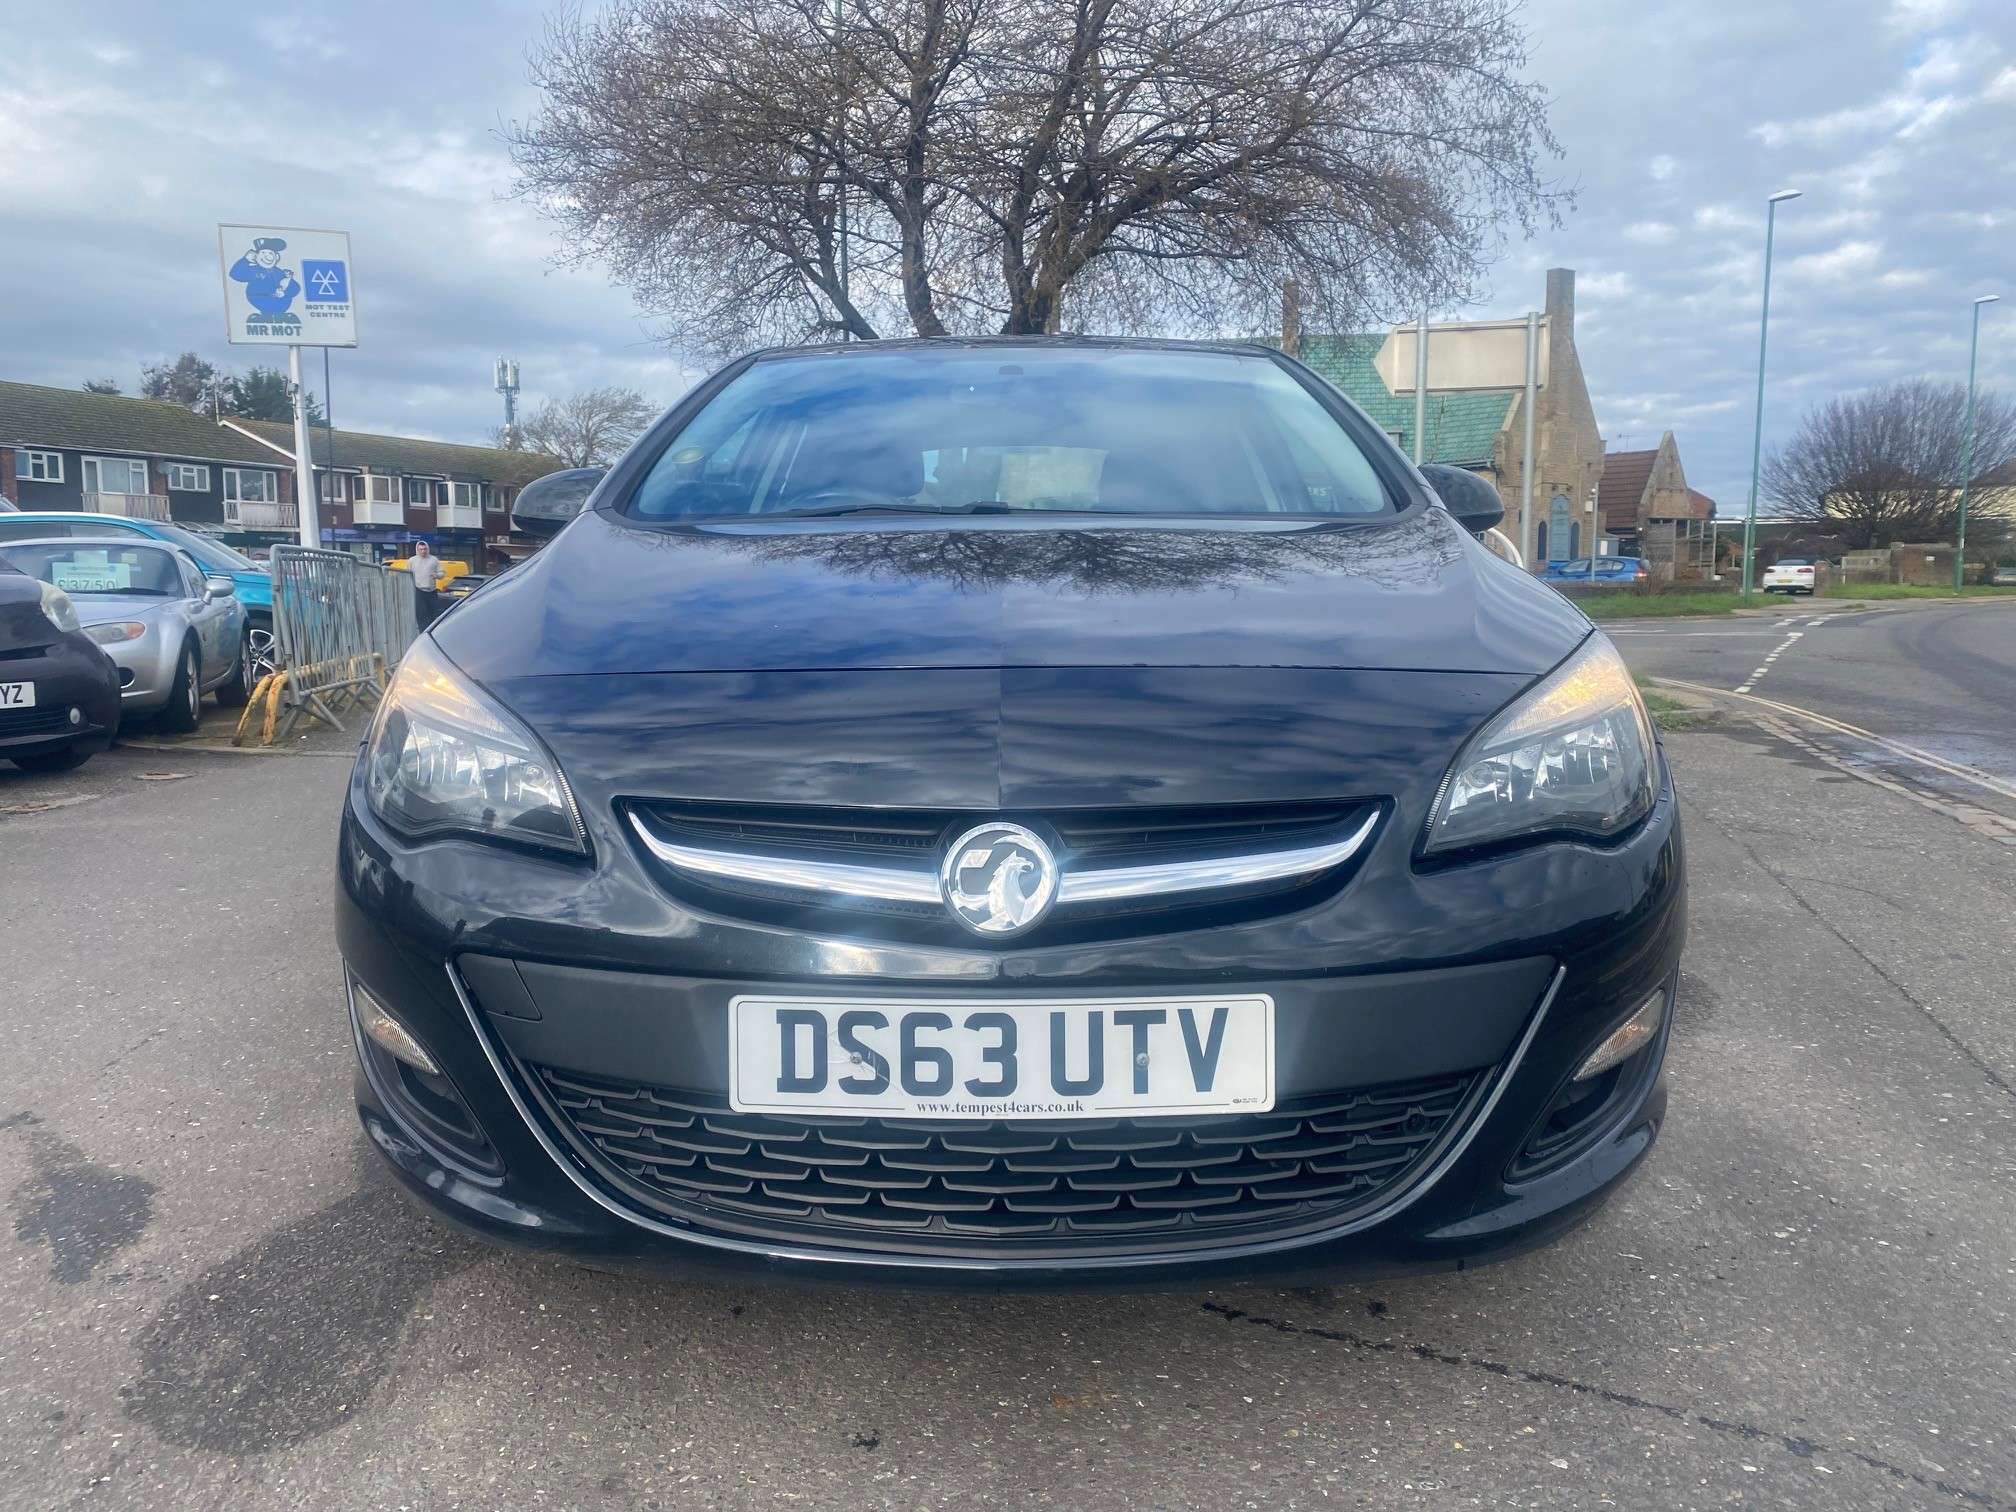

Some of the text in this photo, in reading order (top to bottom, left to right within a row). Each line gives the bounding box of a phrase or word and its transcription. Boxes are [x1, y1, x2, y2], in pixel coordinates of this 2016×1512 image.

[246, 325, 302, 336] MR MOT
[775, 1008, 1230, 1097] DS63 UTV
[917, 1099, 1085, 1116] www.tempest4cars.co.uk
